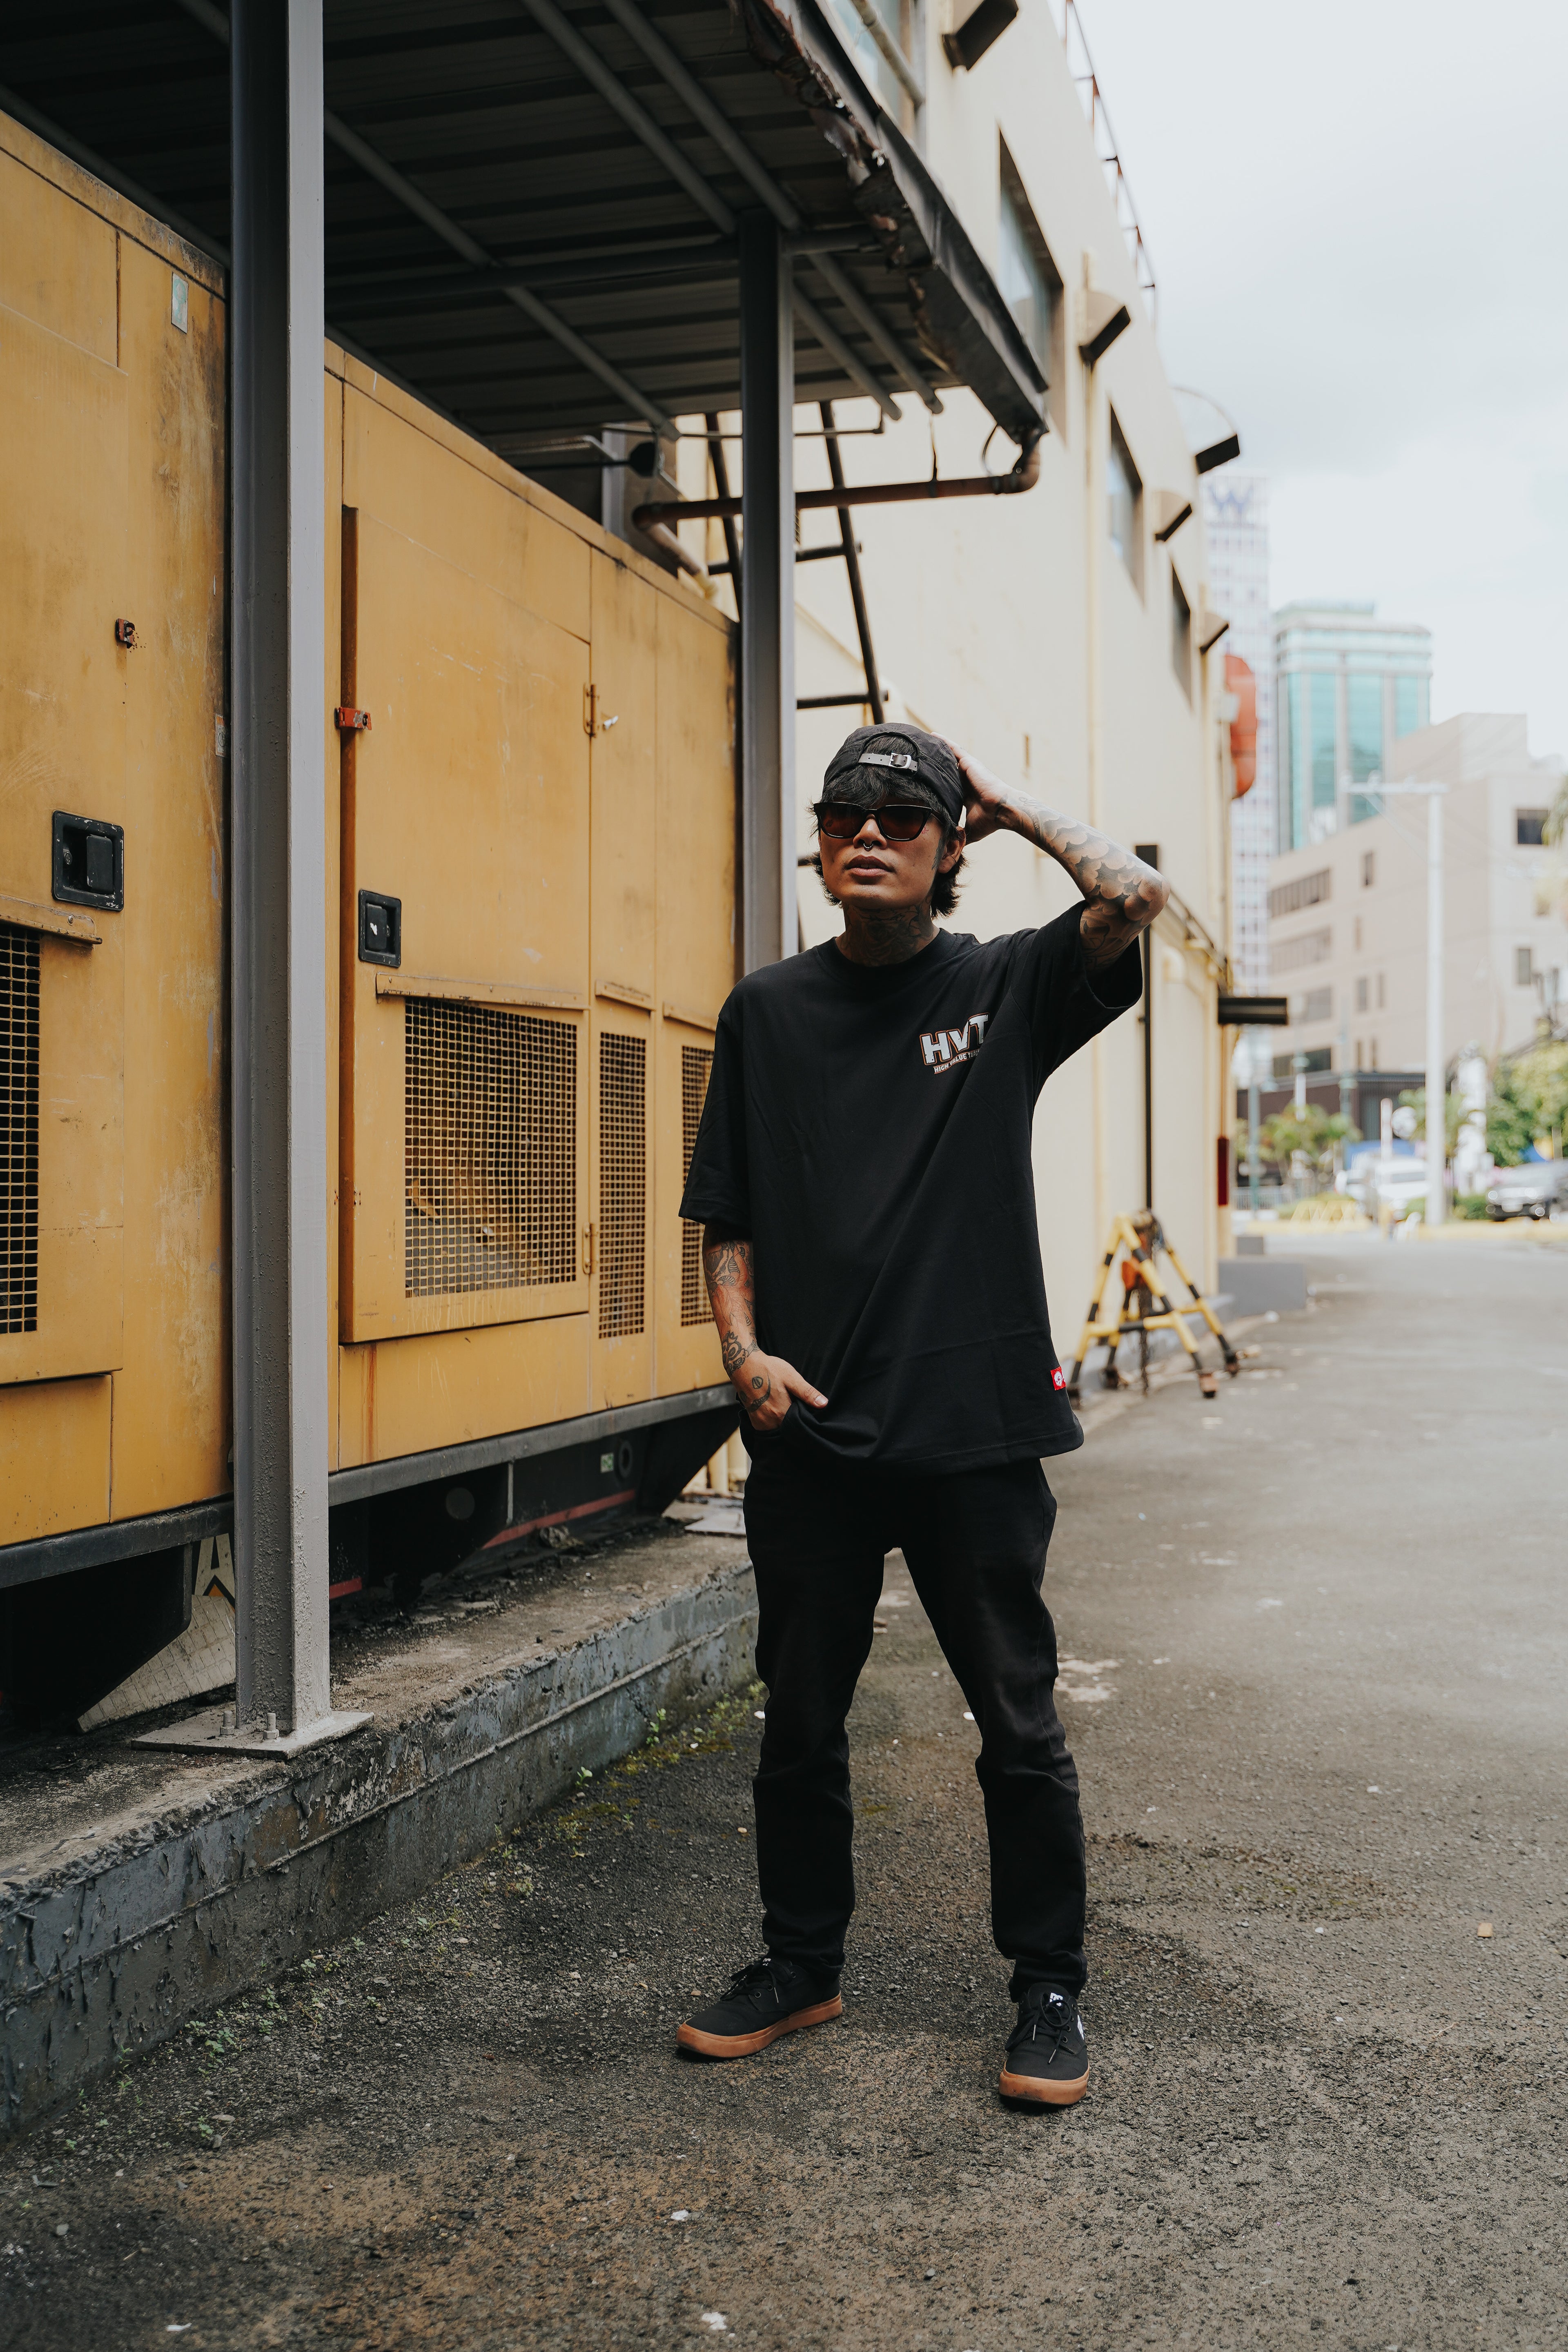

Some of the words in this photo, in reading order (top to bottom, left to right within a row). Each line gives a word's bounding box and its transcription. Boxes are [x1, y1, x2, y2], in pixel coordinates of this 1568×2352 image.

[920, 1013, 989, 1065] HVT
[934, 1062, 949, 1073] HIGH
[949, 1053, 967, 1065] VALUE
